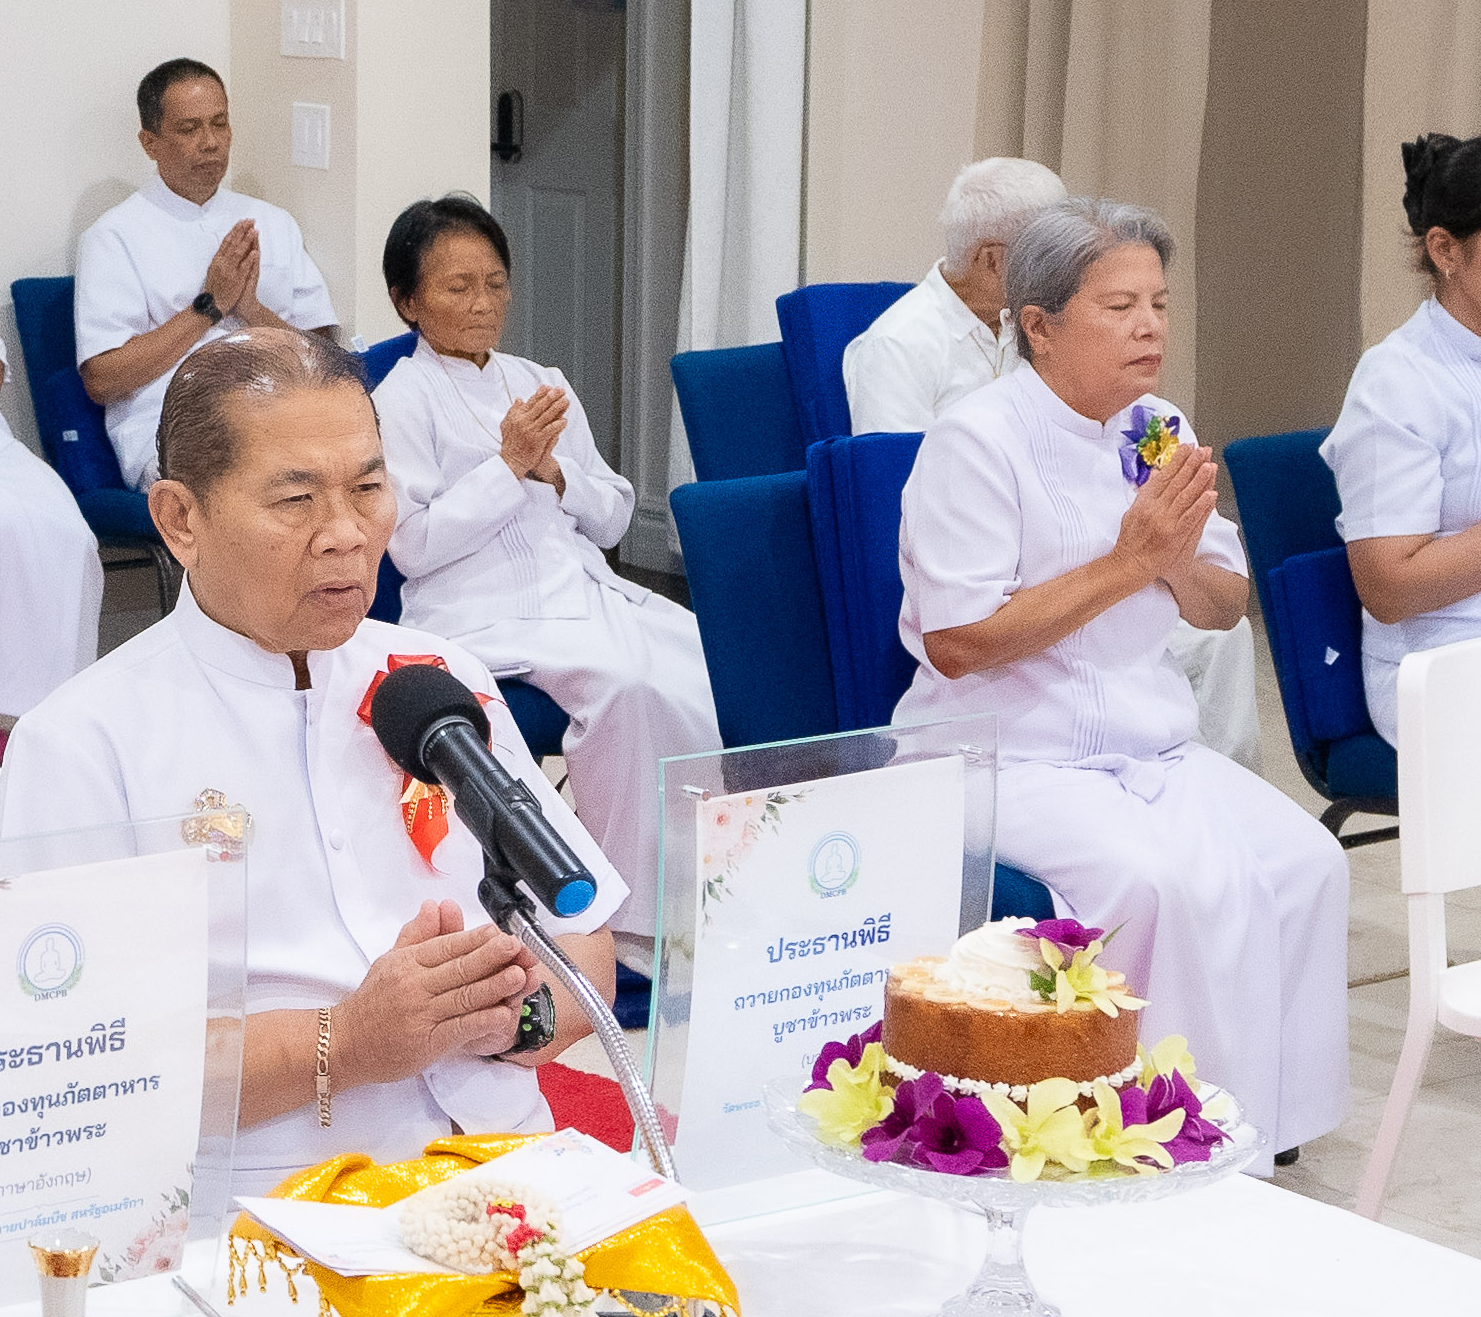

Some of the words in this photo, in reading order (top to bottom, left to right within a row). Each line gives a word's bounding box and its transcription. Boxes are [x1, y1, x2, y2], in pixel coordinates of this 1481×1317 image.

[767, 913, 892, 964] ประธานพิธี
[33, 989, 68, 1002] DMCPB
[734, 968, 890, 1011] ถวายกองทุนภัตตา
[772, 1005, 873, 1043] บูชาข้าวพระ
